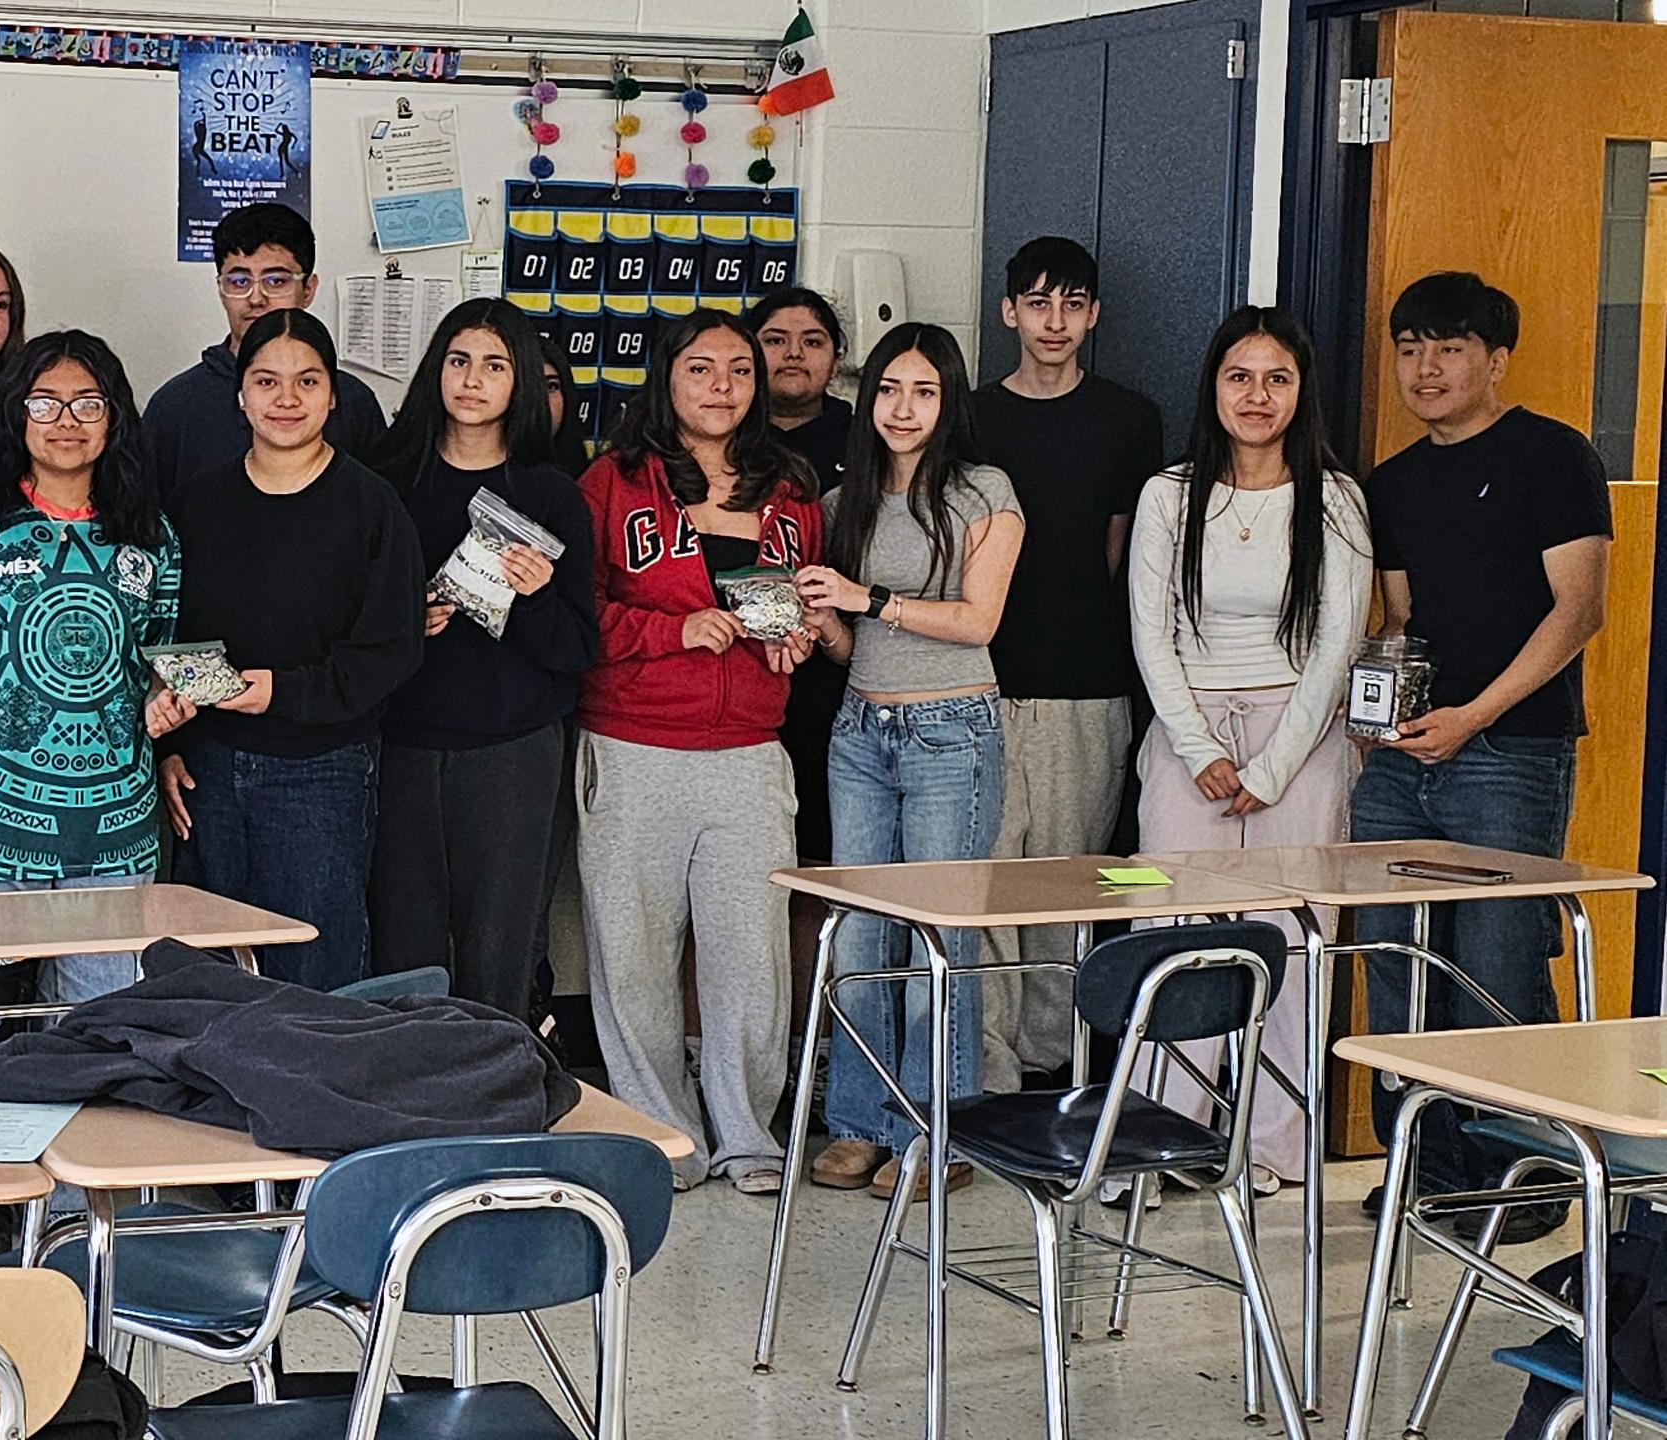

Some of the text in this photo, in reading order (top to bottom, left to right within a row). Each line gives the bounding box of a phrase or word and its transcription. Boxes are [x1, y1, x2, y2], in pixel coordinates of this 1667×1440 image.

[210, 68, 279, 90] CAN'T
[213, 91, 275, 113] STOP
[224, 114, 261, 132] THE
[211, 132, 277, 153] BEAT
[523, 255, 787, 283] 01 02 03 04 05 06
[569, 332, 643, 355] 08 09
[578, 402, 590, 423] 4
